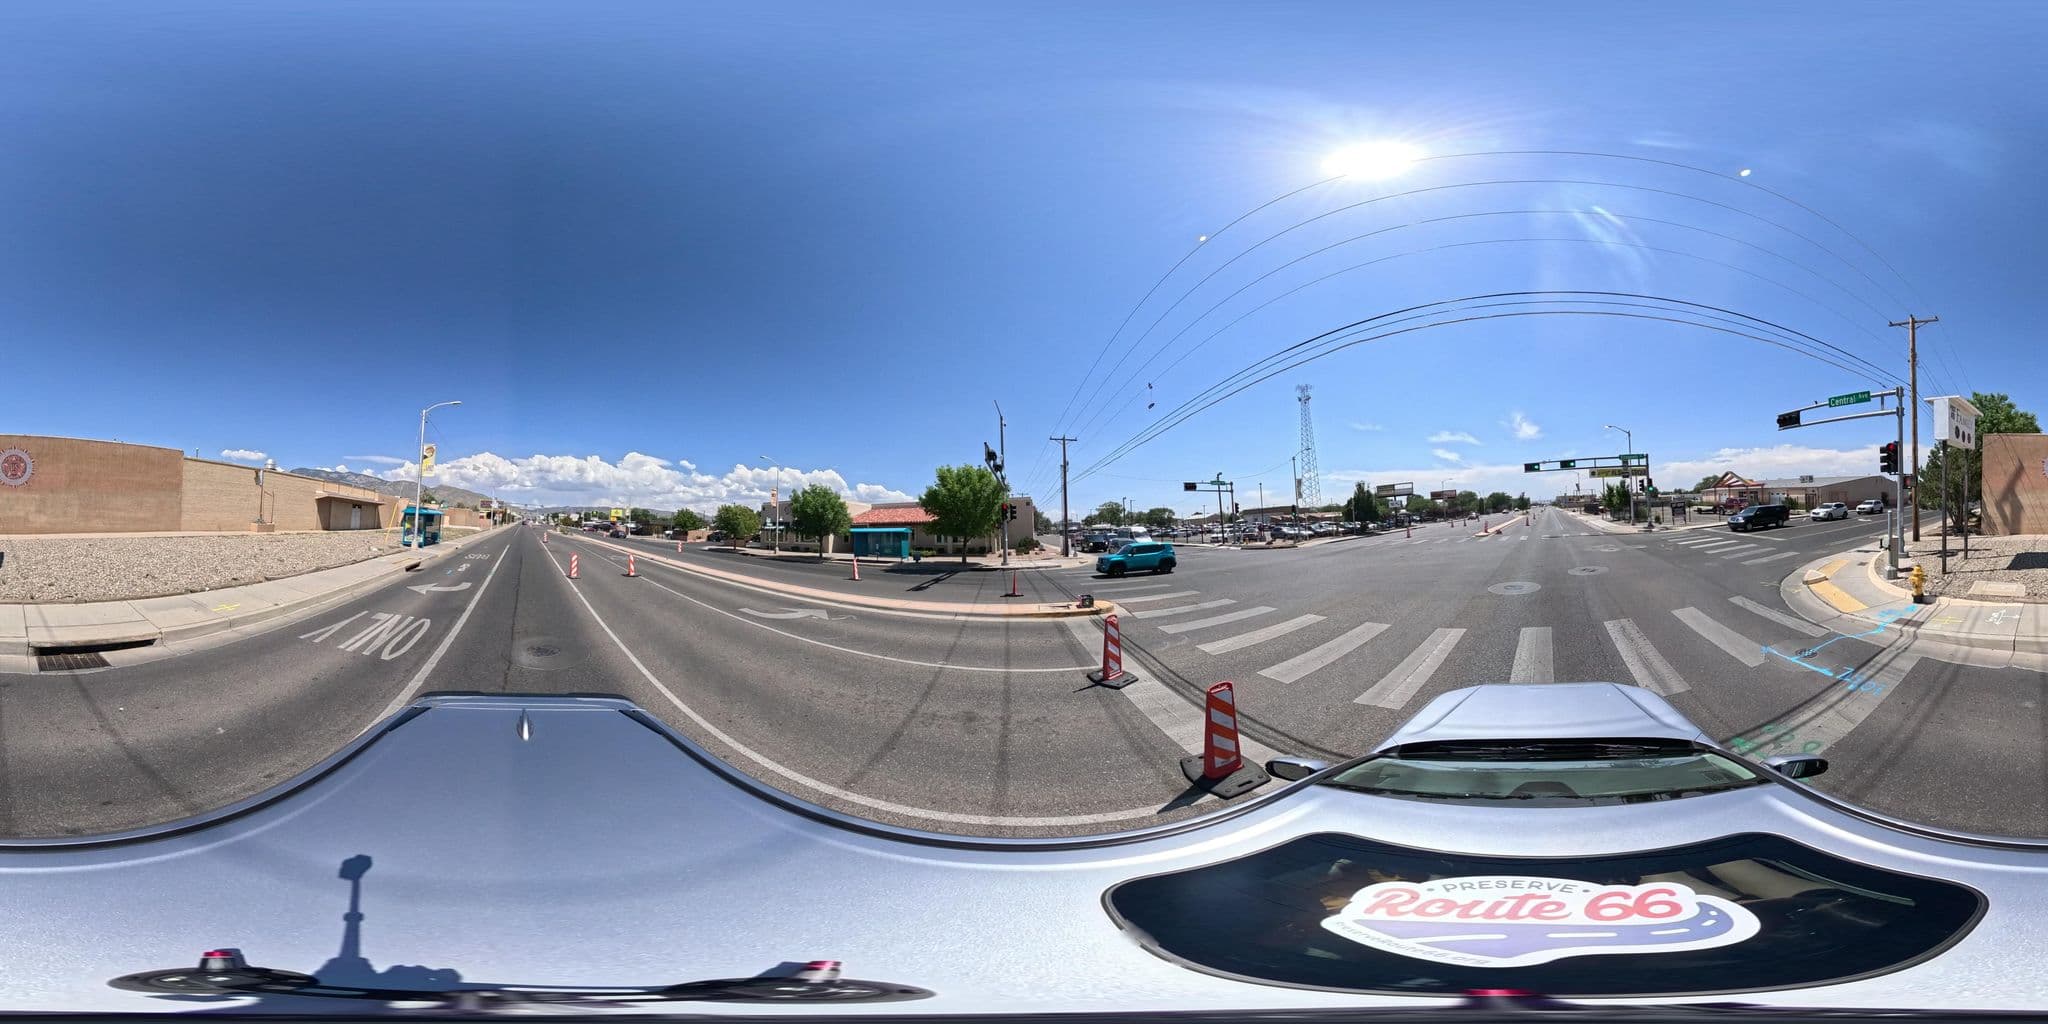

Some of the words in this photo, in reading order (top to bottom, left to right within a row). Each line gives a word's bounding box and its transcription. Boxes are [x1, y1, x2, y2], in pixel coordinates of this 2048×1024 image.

[1830, 395, 1856, 407] Central
[299, 610, 431, 660] ONLY
[1442, 880, 1578, 894] PRESERVE
[1363, 887, 1573, 921] Route
[1584, 888, 1683, 921] 66
